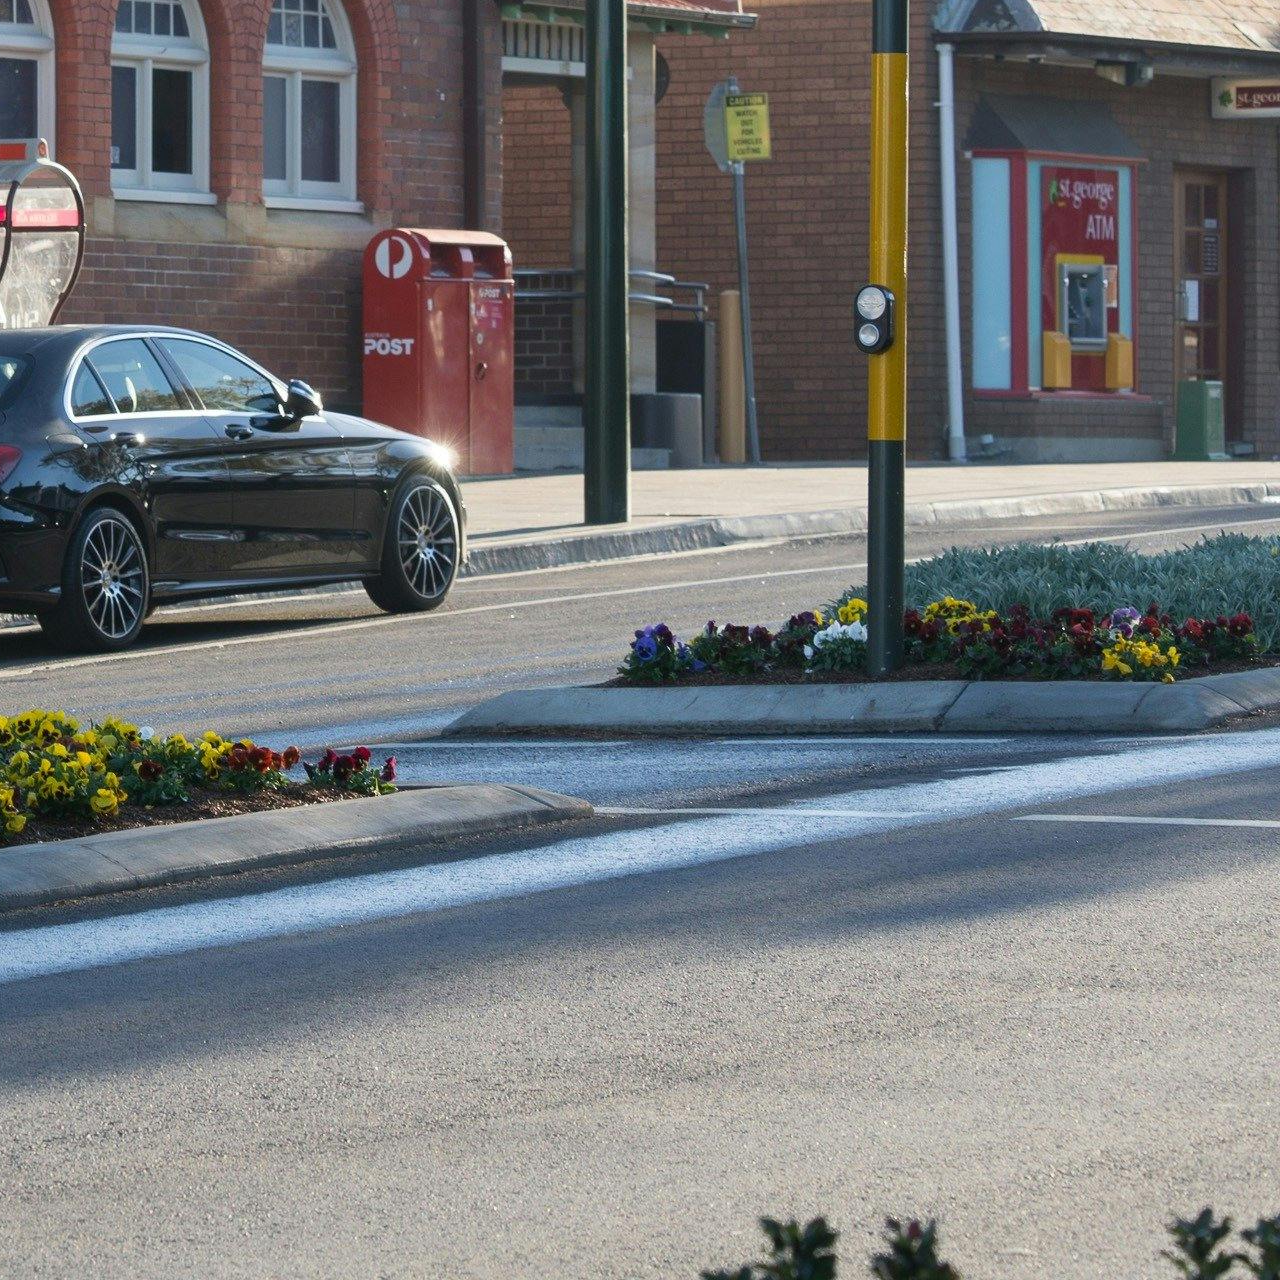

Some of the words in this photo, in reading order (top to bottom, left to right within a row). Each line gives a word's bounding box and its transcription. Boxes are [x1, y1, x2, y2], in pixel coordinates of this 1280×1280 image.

[1060, 177, 1115, 210] st.george
[1085, 214, 1115, 240] ATM
[364, 338, 415, 355] POST
